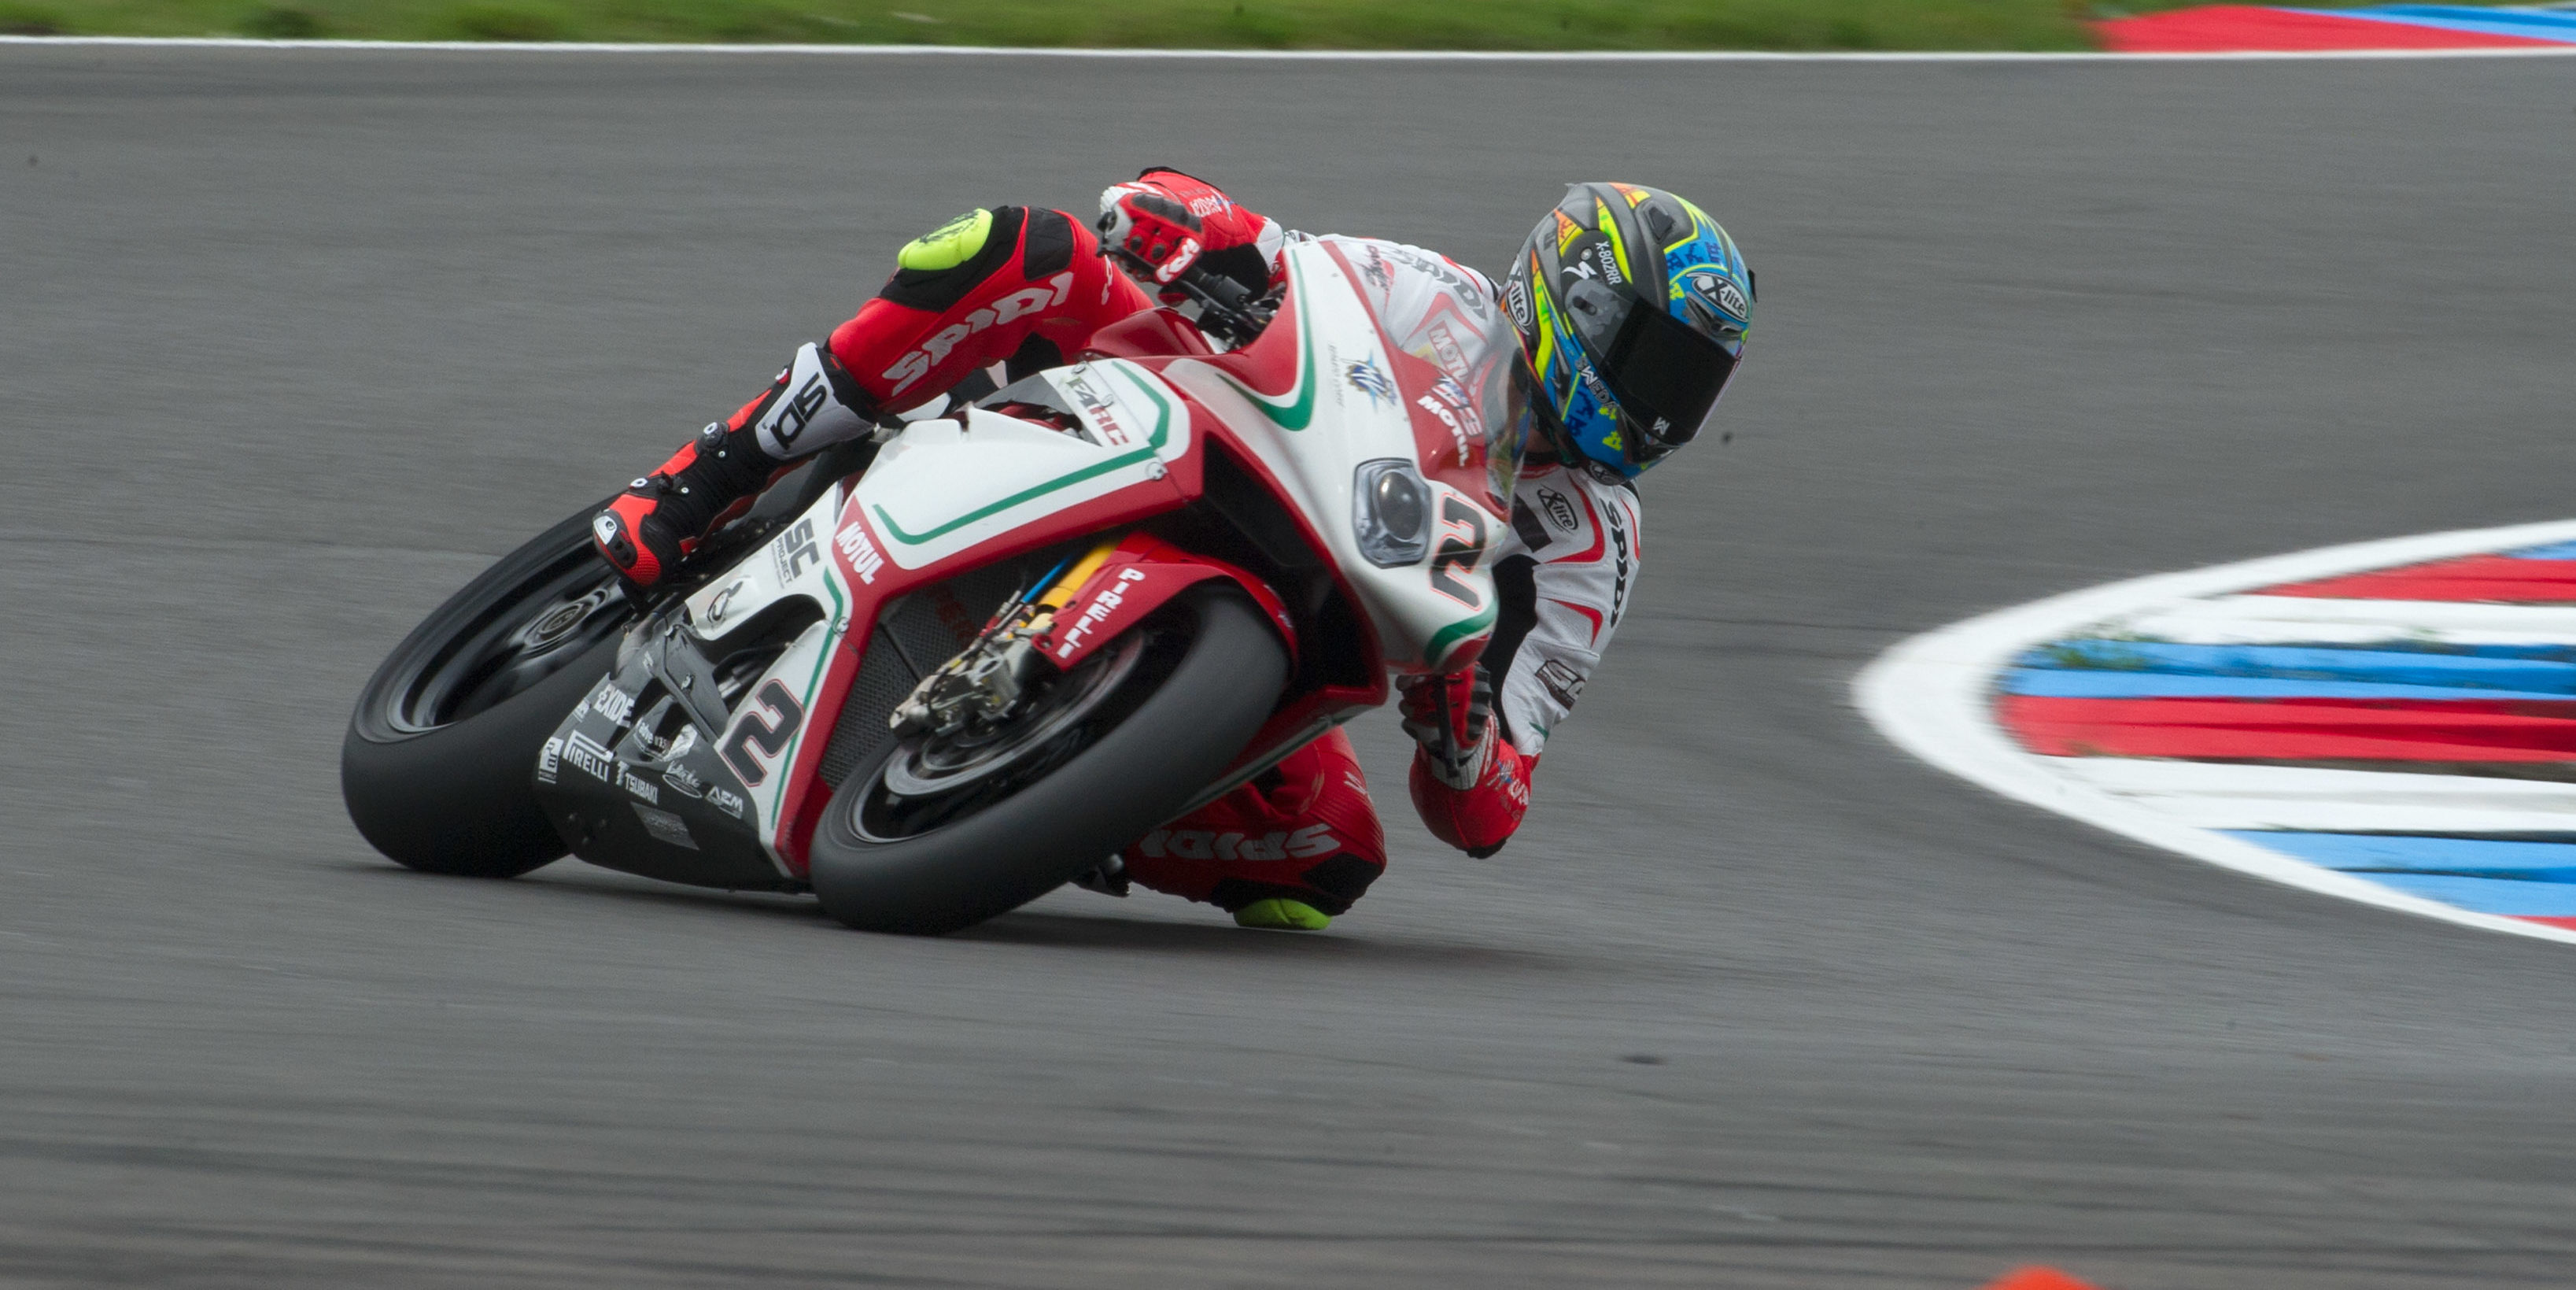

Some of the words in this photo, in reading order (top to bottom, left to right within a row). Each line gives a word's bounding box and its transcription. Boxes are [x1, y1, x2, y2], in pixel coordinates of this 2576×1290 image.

[1594, 241, 1622, 286] X-802RR
[1699, 276, 1746, 316] X-lite
[882, 272, 1074, 396] SPIDI
[1417, 395, 1469, 467] MOTUL
[1538, 487, 1574, 530] X-lite
[776, 537, 792, 583] PROJECT
[784, 518, 820, 579] SC
[835, 521, 884, 585] MOTUL
[1428, 491, 1489, 612] 2
[1600, 497, 1628, 628] SPIDI
[1057, 567, 1146, 659] PIRELLI
[593, 683, 635, 728] EXIDE
[719, 678, 805, 787] 2
[562, 730, 614, 782] PIRELLI
[626, 772, 658, 805] TSUBAKI
[1138, 823, 1341, 862] SPIDI
